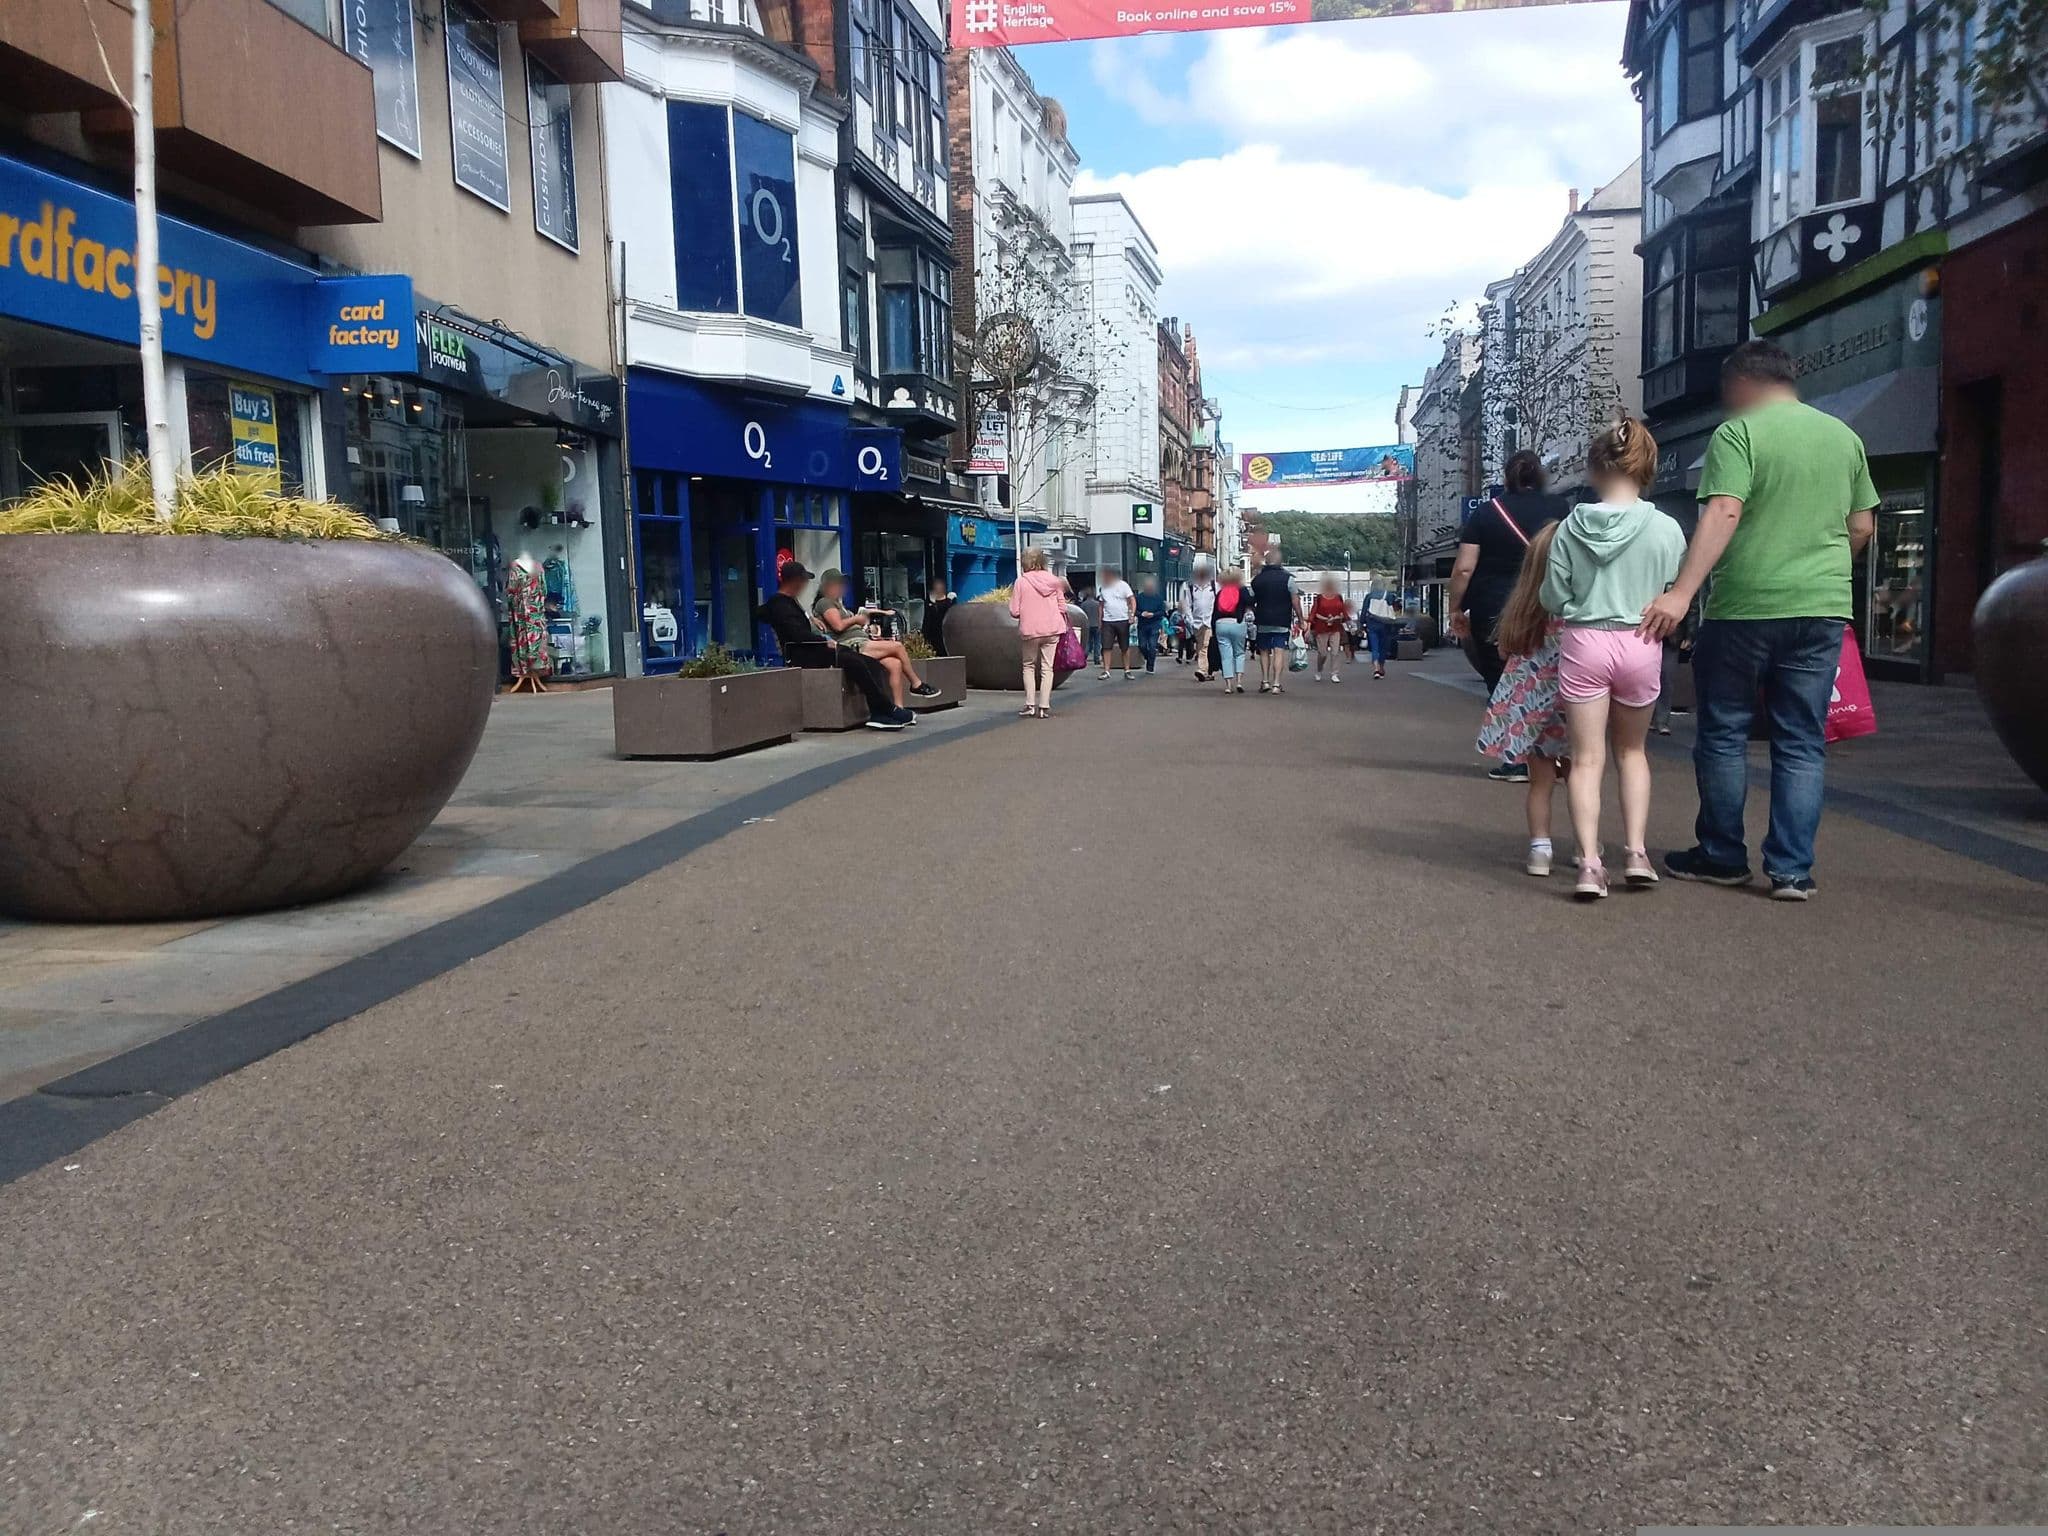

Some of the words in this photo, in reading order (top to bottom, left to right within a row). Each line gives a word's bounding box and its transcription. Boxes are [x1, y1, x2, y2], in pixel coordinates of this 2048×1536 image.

[1003, 3, 1046, 16] English
[1117, 11, 1152, 22] Book
[1155, 9, 1198, 20] online
[1202, 7, 1229, 18] and
[1233, 4, 1266, 15] save
[1269, 1, 1297, 14] 15%
[1002, 16, 1055, 28] Heritage
[456, 43, 494, 82] FOOTWEAR
[459, 82, 496, 118] CLOTHING
[458, 119, 502, 157] ACCESSORIES
[0, 200, 216, 339] rdfacory
[340, 299, 384, 321] card
[329, 325, 399, 349] factory
[431, 325, 466, 359] FLEX
[432, 351, 468, 373] FOOTWEAR
[234, 393, 258, 420] Buy
[261, 400, 270, 417] 3
[986, 421, 1006, 432] LET
[236, 445, 252, 461] 4th
[253, 447, 275, 464] free
[744, 421, 772, 468] O2
[1311, 452, 1327, 462] SEA
[1328, 451, 1343, 461] LIFE
[857, 446, 888, 480] O2
